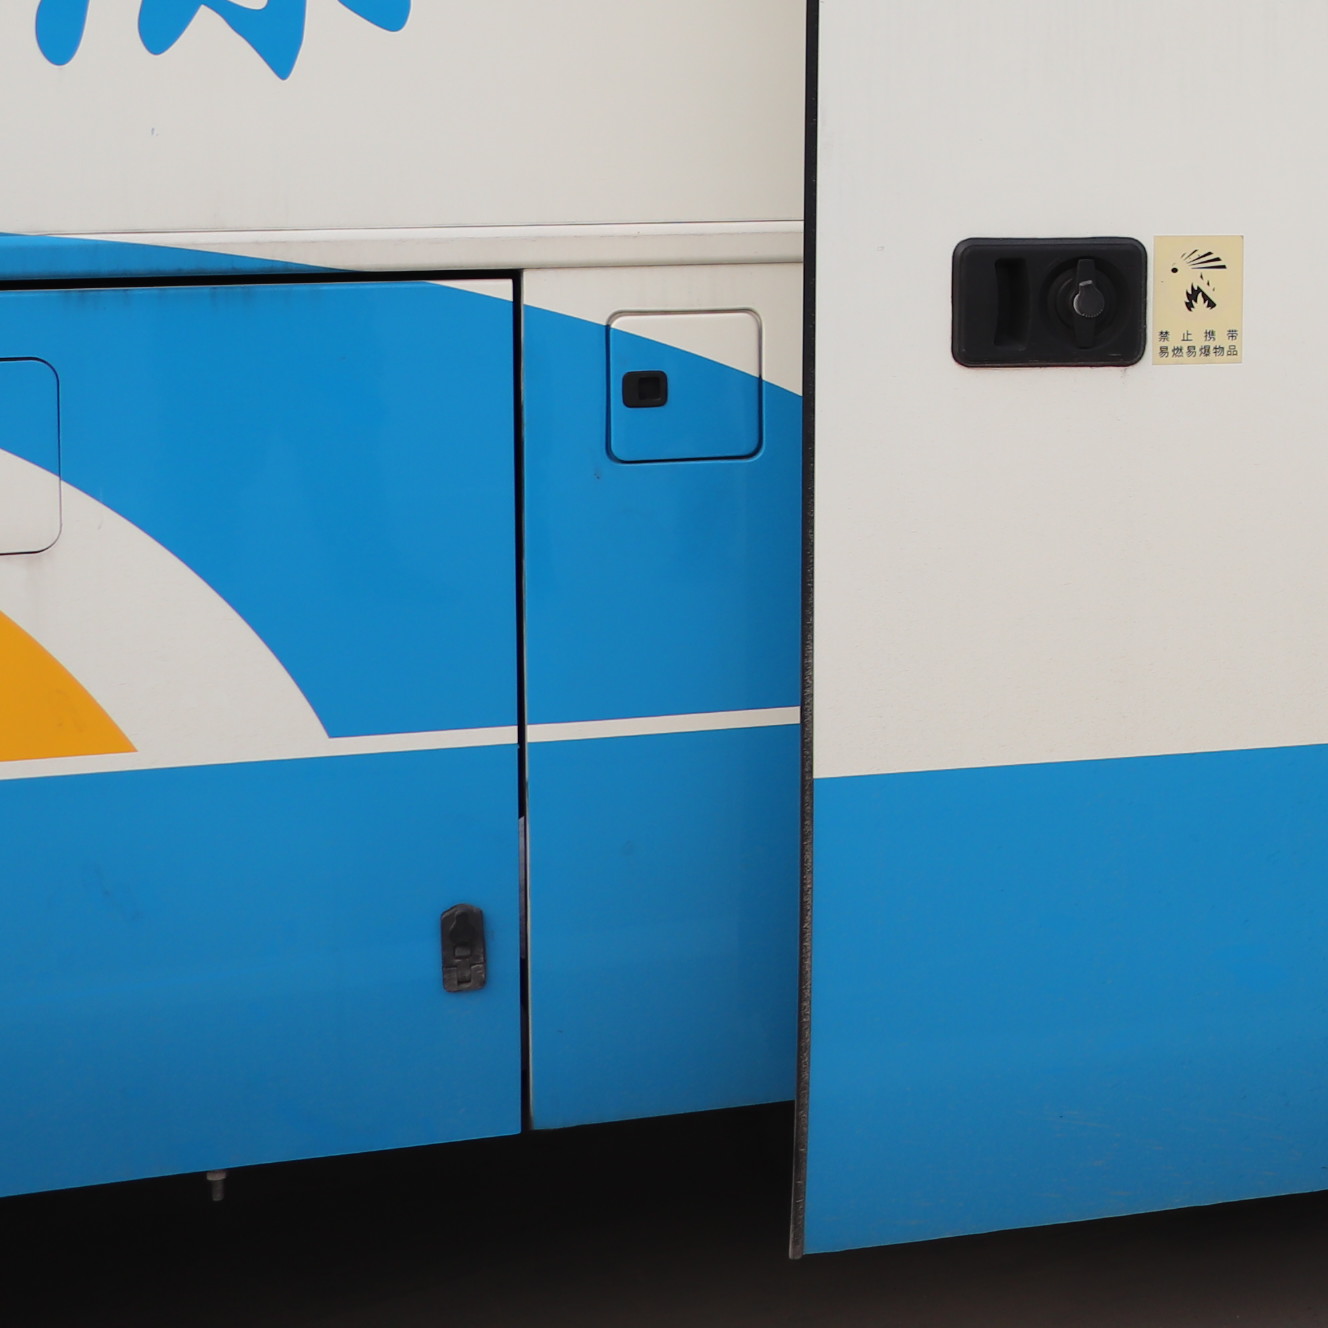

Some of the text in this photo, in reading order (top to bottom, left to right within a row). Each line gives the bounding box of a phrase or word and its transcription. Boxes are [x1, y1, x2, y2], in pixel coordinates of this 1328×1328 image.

[1158, 329, 1238, 342] 禁止携带
[1158, 344, 1238, 358] 易燃易爆物品
